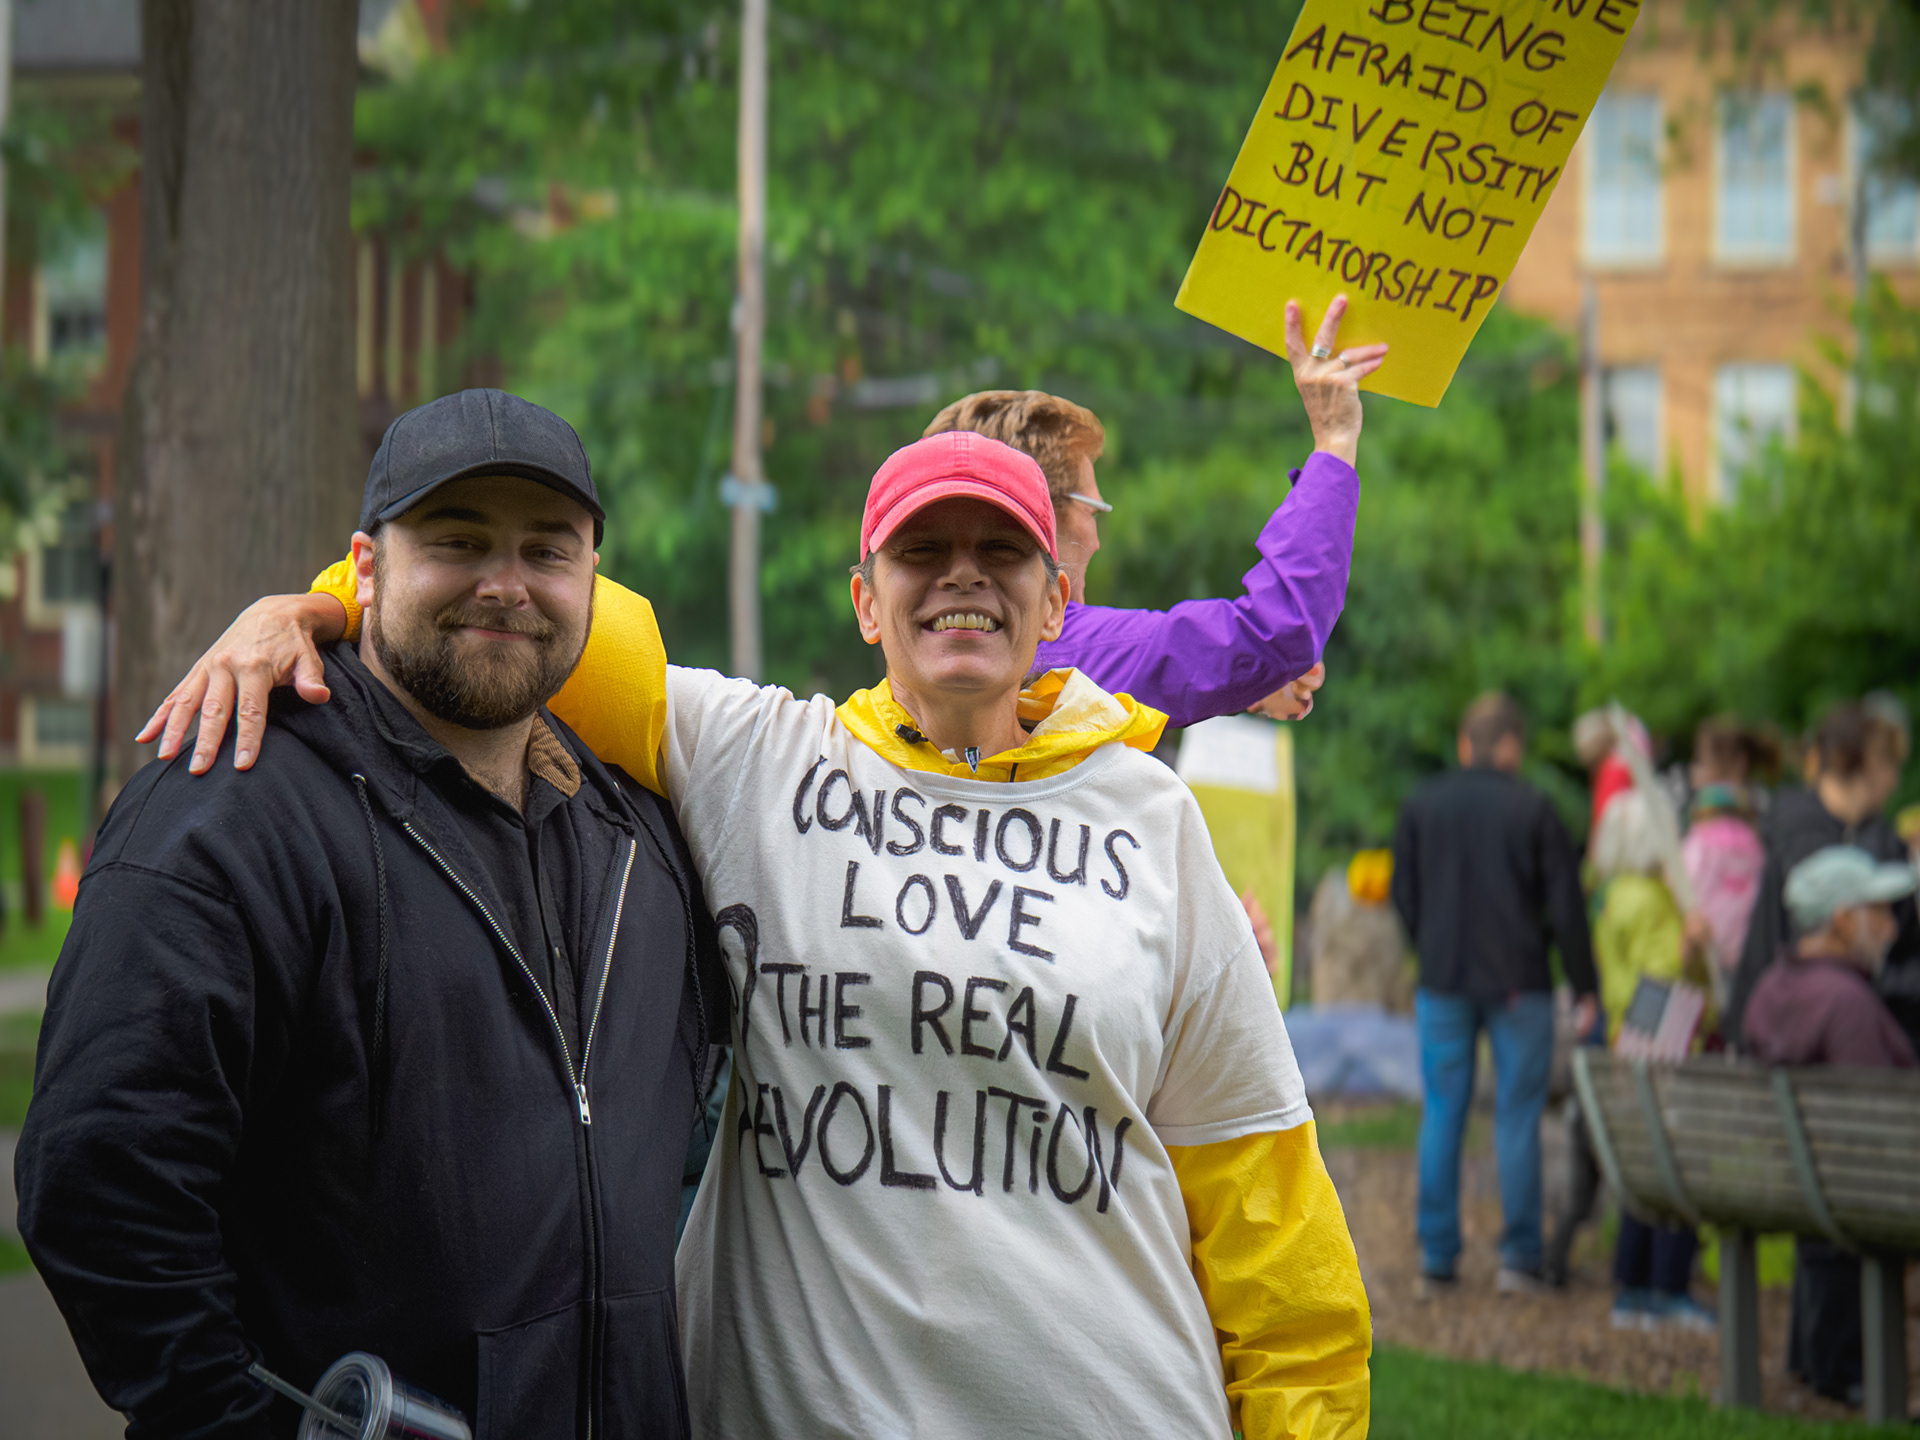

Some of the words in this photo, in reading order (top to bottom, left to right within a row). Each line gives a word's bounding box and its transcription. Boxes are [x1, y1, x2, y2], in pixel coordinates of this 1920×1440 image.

[1286, 23, 1487, 112] AFRAID
[1509, 99, 1579, 145] OF
[1369, 0, 1566, 71] BEING
[1272, 141, 1388, 206] BUT
[1403, 191, 1515, 256] NOT
[1273, 82, 1559, 203] DIVERSITY
[1209, 186, 1499, 322] DICTATORSHIP
[792, 755, 1142, 901] CONSCIOUS
[840, 861, 1056, 963] LOVE
[760, 962, 872, 1050] THE
[910, 970, 1091, 1081] REAL
